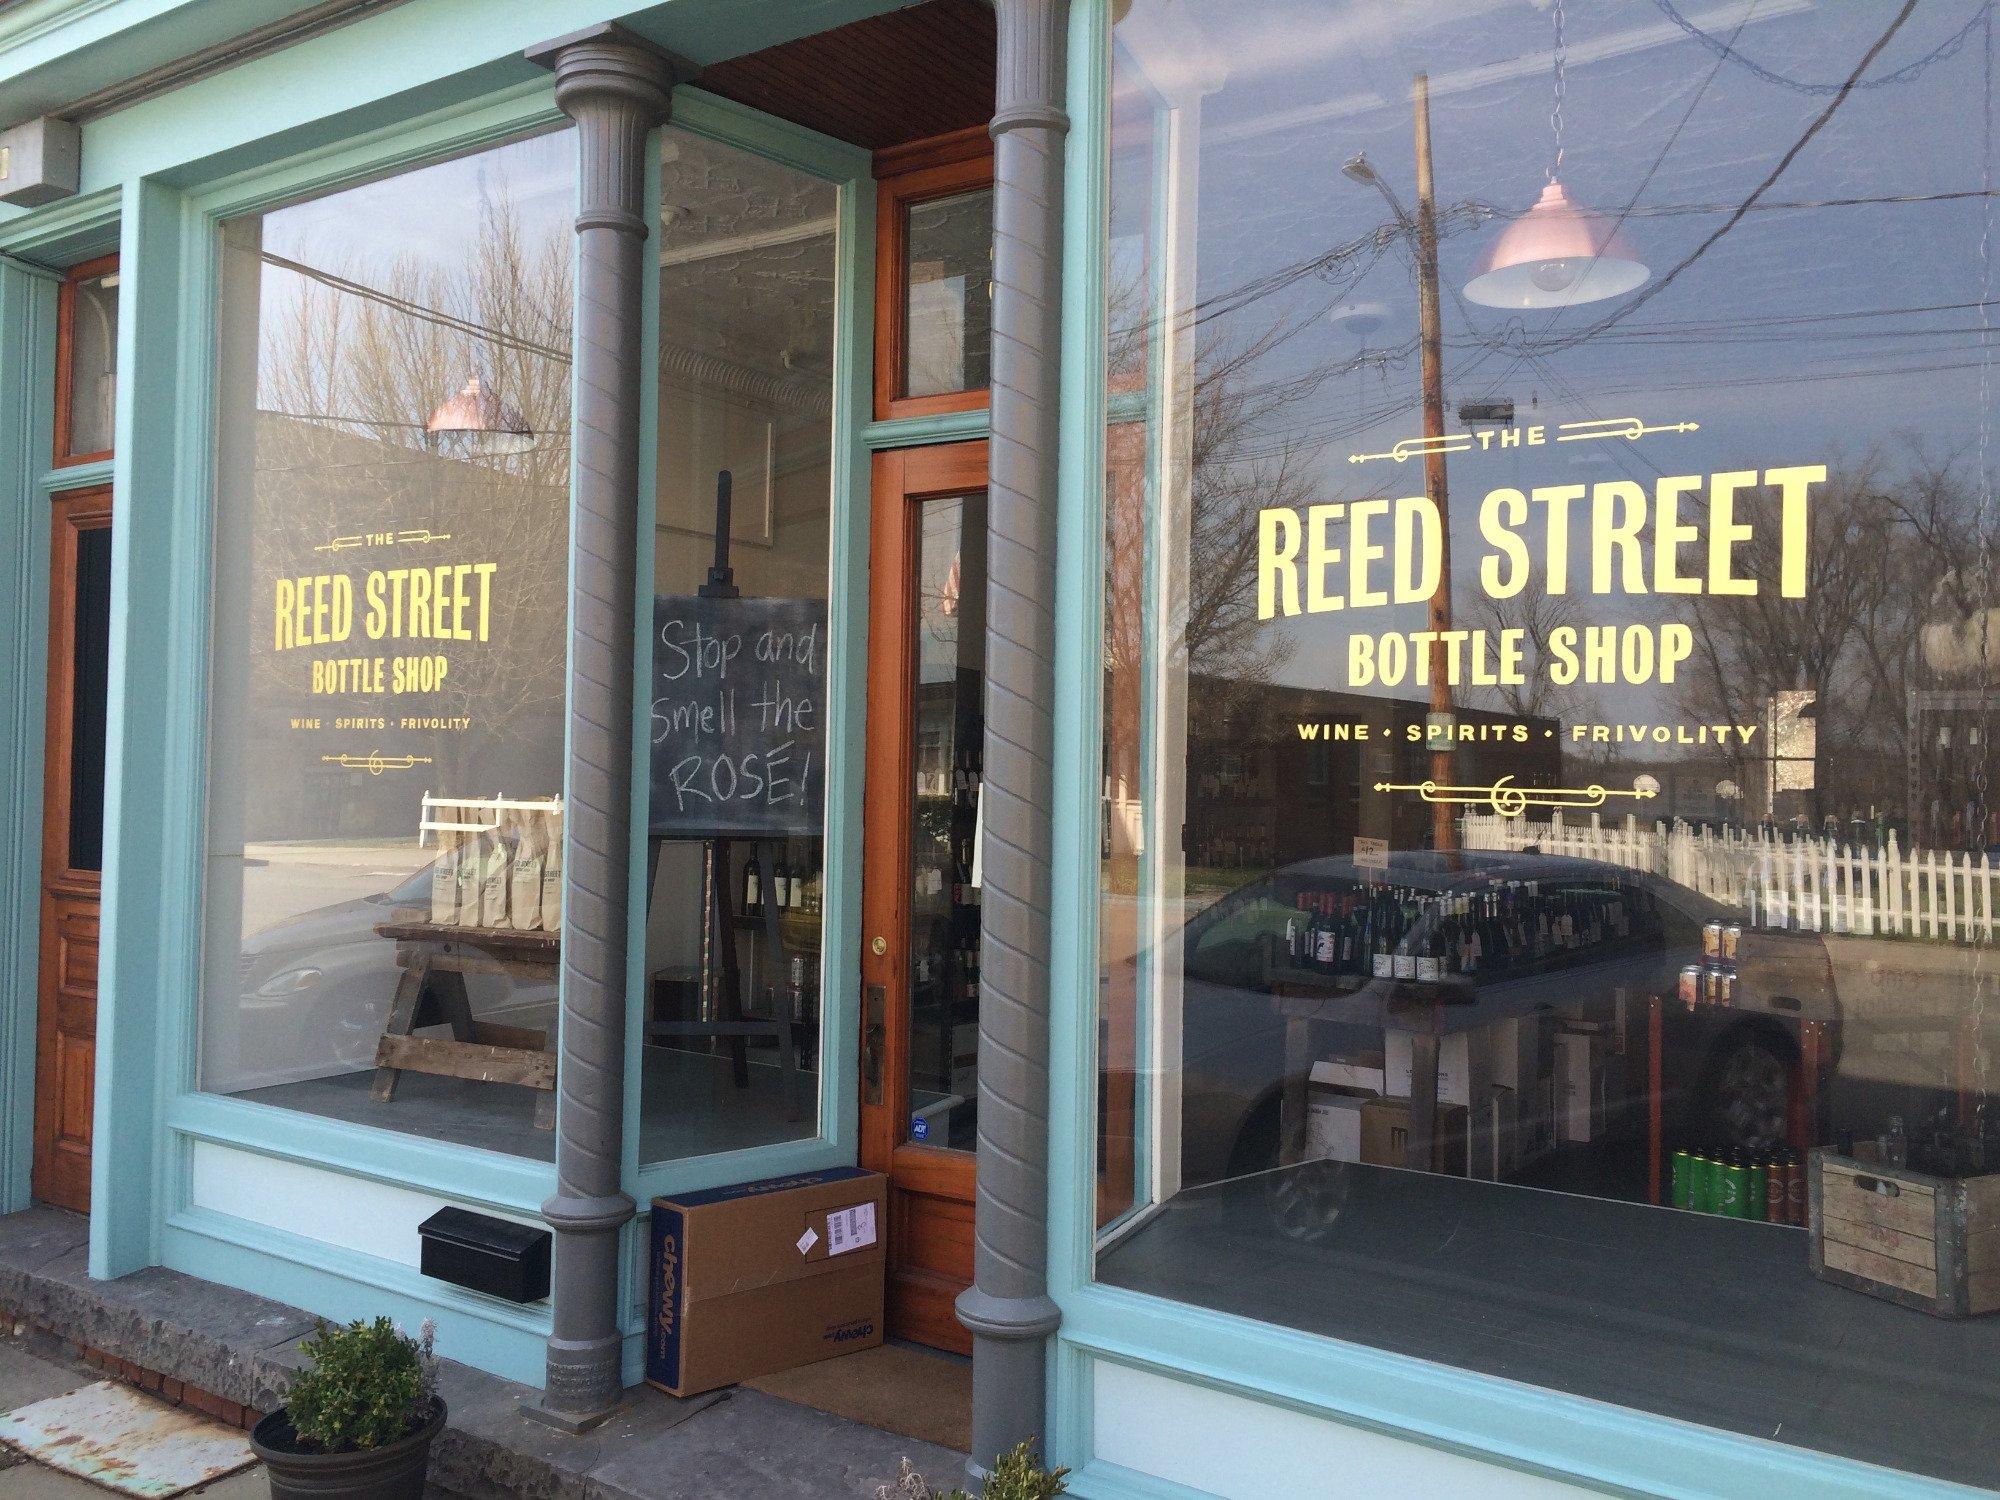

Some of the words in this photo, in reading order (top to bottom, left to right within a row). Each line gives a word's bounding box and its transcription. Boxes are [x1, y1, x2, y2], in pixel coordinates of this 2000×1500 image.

[1477, 425, 1546, 452] THE
[366, 532, 395, 546] THE
[1258, 491, 1443, 620] REED
[1480, 465, 1826, 599] STREET
[274, 573, 354, 651] REED
[365, 561, 498, 642] STREET
[311, 657, 385, 695] BOTTLE
[391, 655, 449, 695] SHOP
[661, 619, 742, 680] Stop
[754, 622, 818, 674] and
[1348, 629, 1525, 687] BOTTLE
[1548, 623, 1693, 685] SHOP
[290, 717, 321, 730] WINE
[334, 717, 385, 730] SPIRITS
[400, 717, 471, 730] FRIVOLITY
[750, 680, 815, 733] the
[1297, 724, 1370, 741] WINE
[1406, 724, 1529, 743] SPIRITS
[1572, 725, 1757, 744] FRIVOLITY
[668, 739, 811, 812] ROSÉ!
